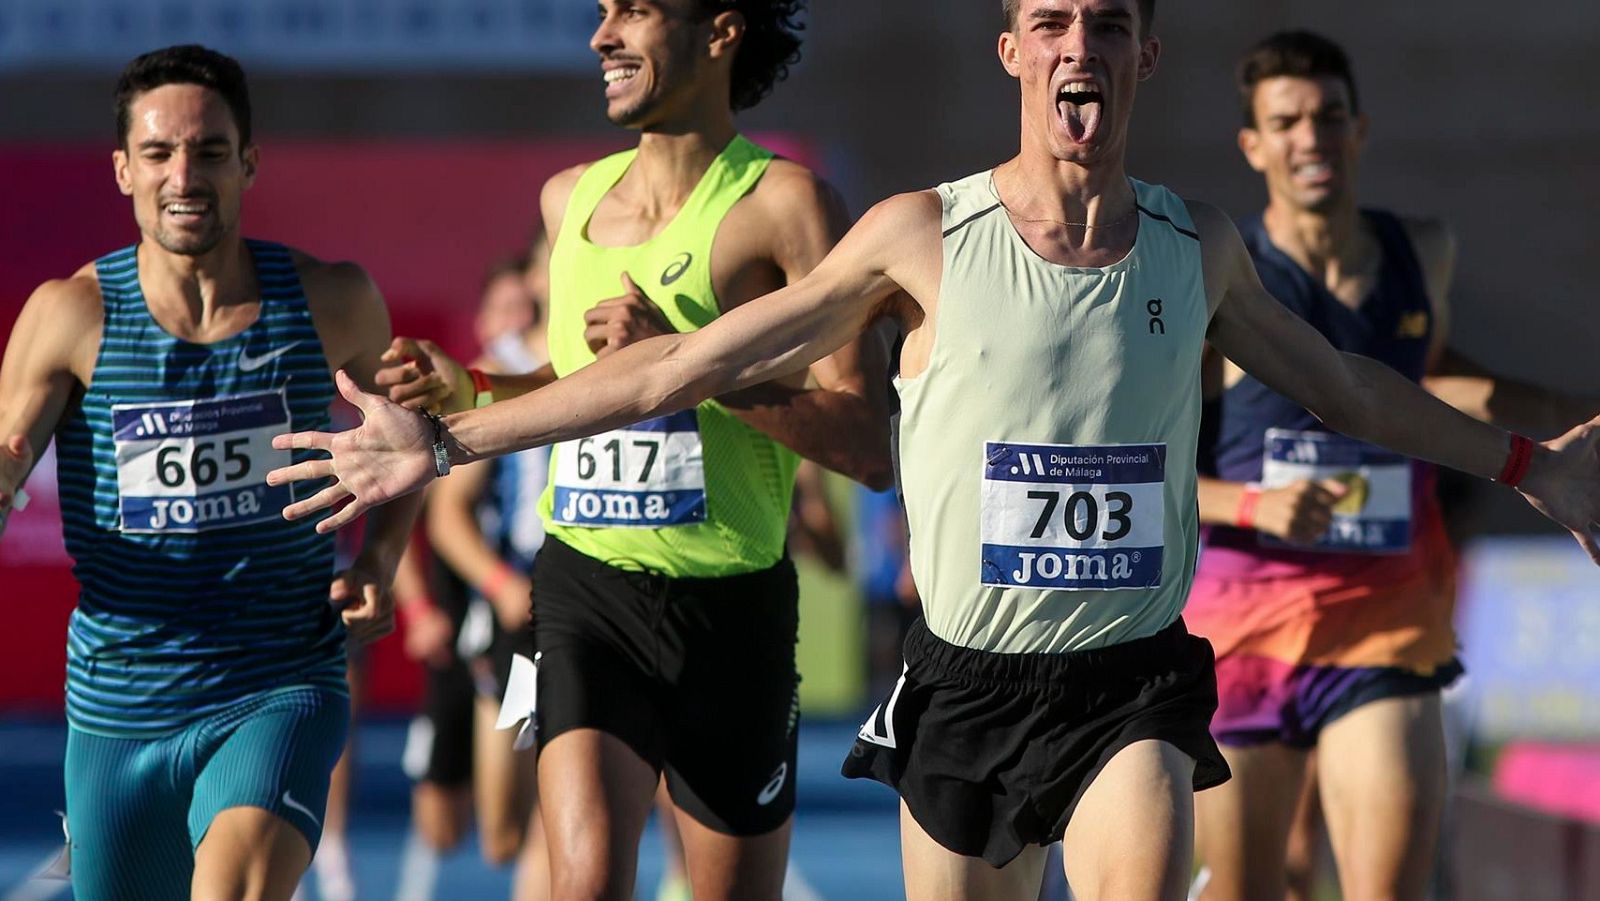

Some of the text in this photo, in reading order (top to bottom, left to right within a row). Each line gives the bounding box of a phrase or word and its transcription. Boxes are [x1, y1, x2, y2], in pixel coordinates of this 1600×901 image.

[156, 437, 251, 488] 665
[577, 438, 660, 483] 617
[1049, 467, 1102, 479] de Málaga
[1050, 453, 1149, 466] Diputación Provincial
[1027, 490, 1133, 541] 703
